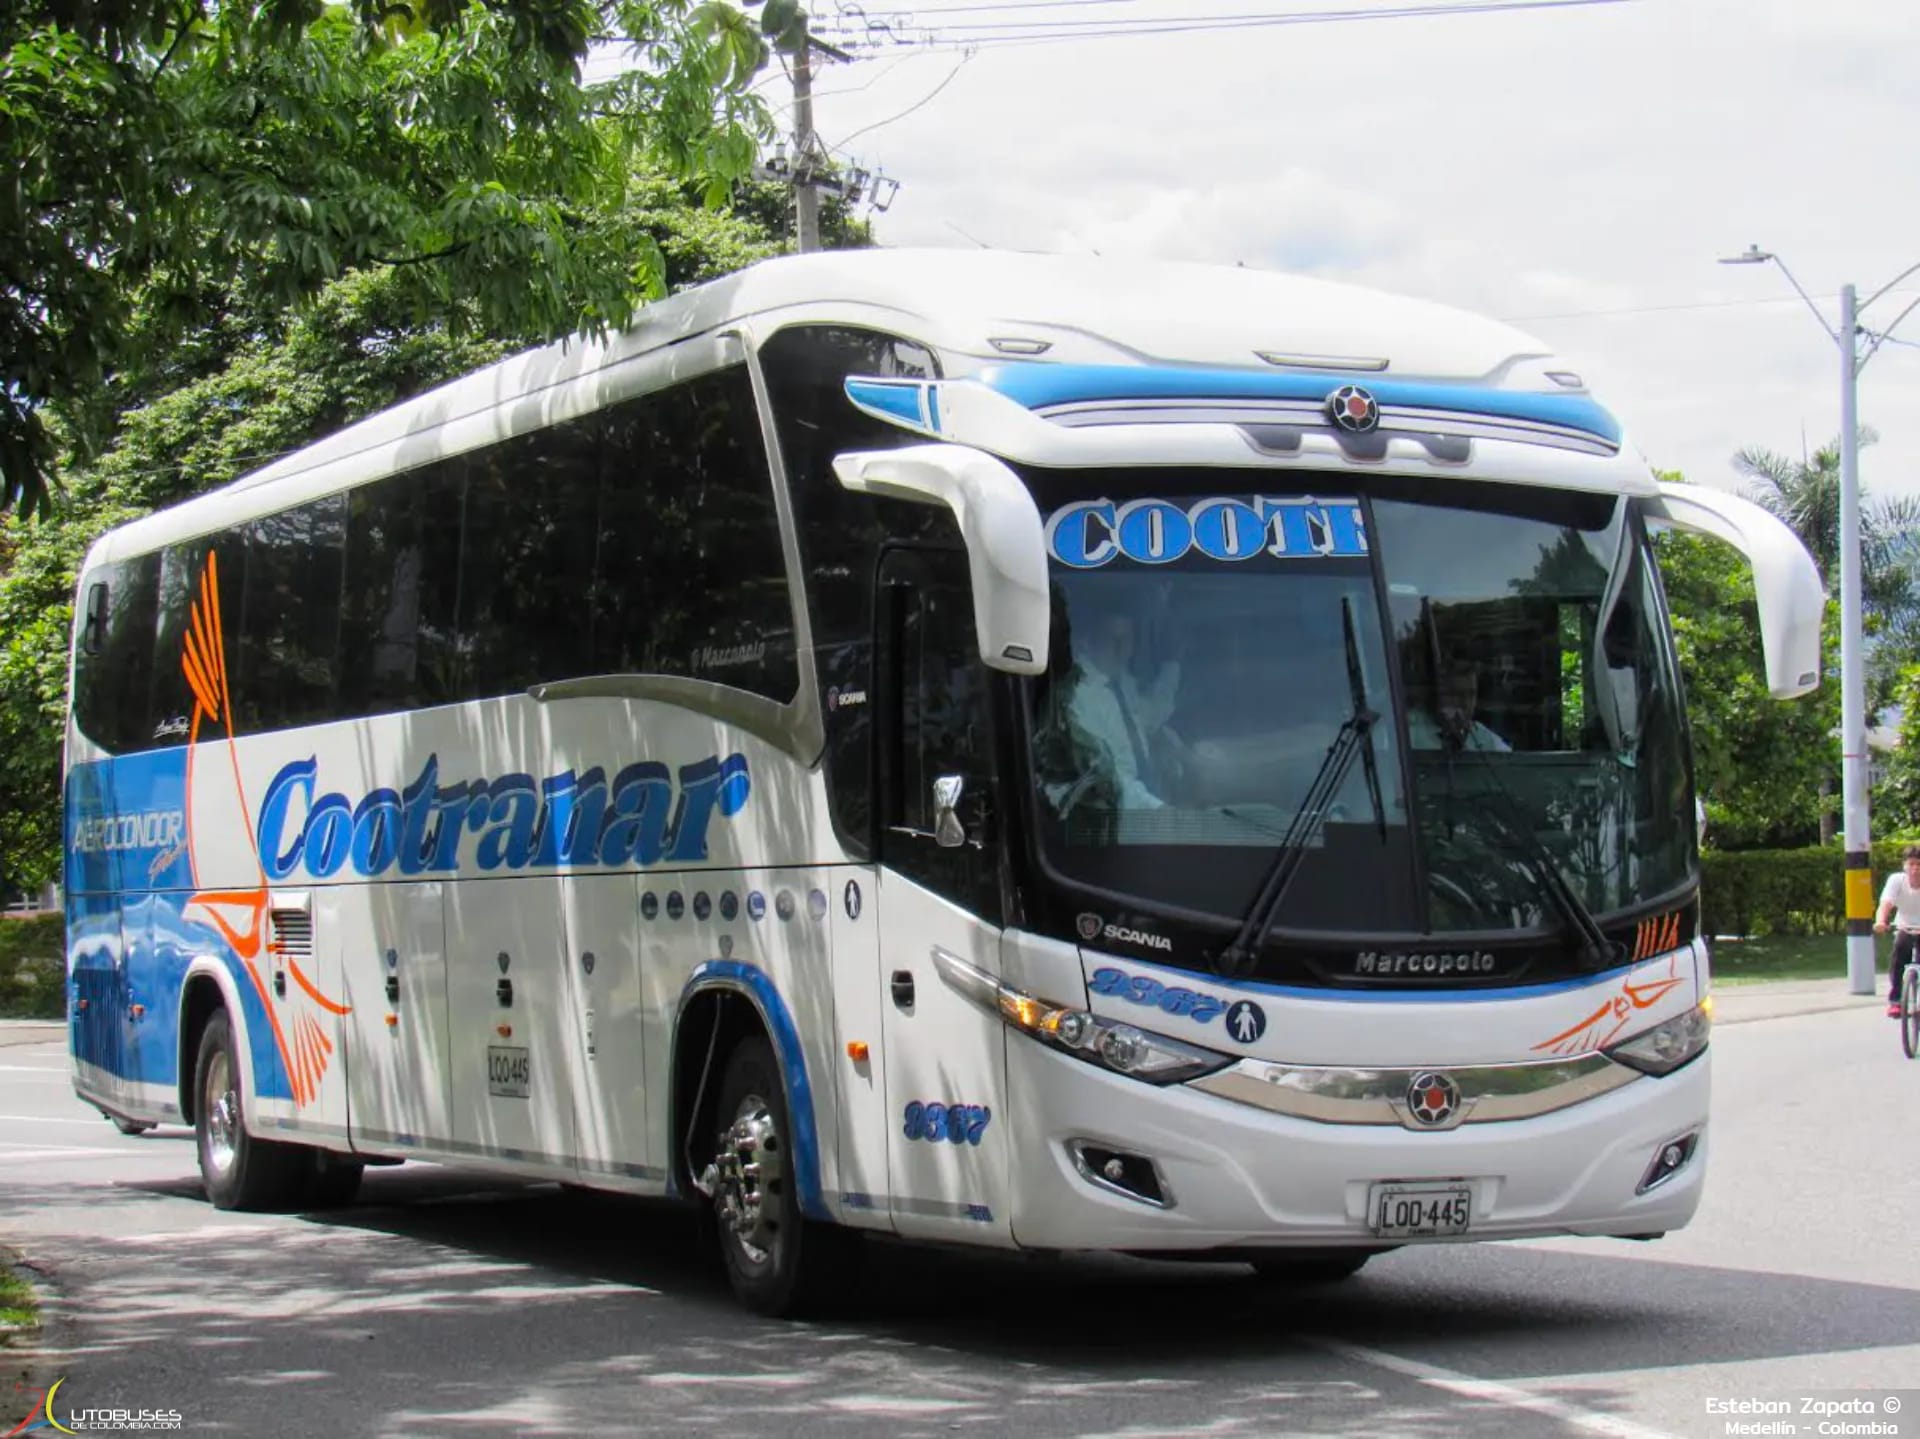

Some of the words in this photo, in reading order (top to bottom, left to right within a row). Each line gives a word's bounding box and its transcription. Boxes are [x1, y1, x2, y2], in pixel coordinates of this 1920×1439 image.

[72, 808, 183, 854] AEROCONDOR
[257, 752, 751, 880] Cootranar
[1104, 924, 1172, 952] SCANIA
[1355, 950, 1495, 974] Marcopolo
